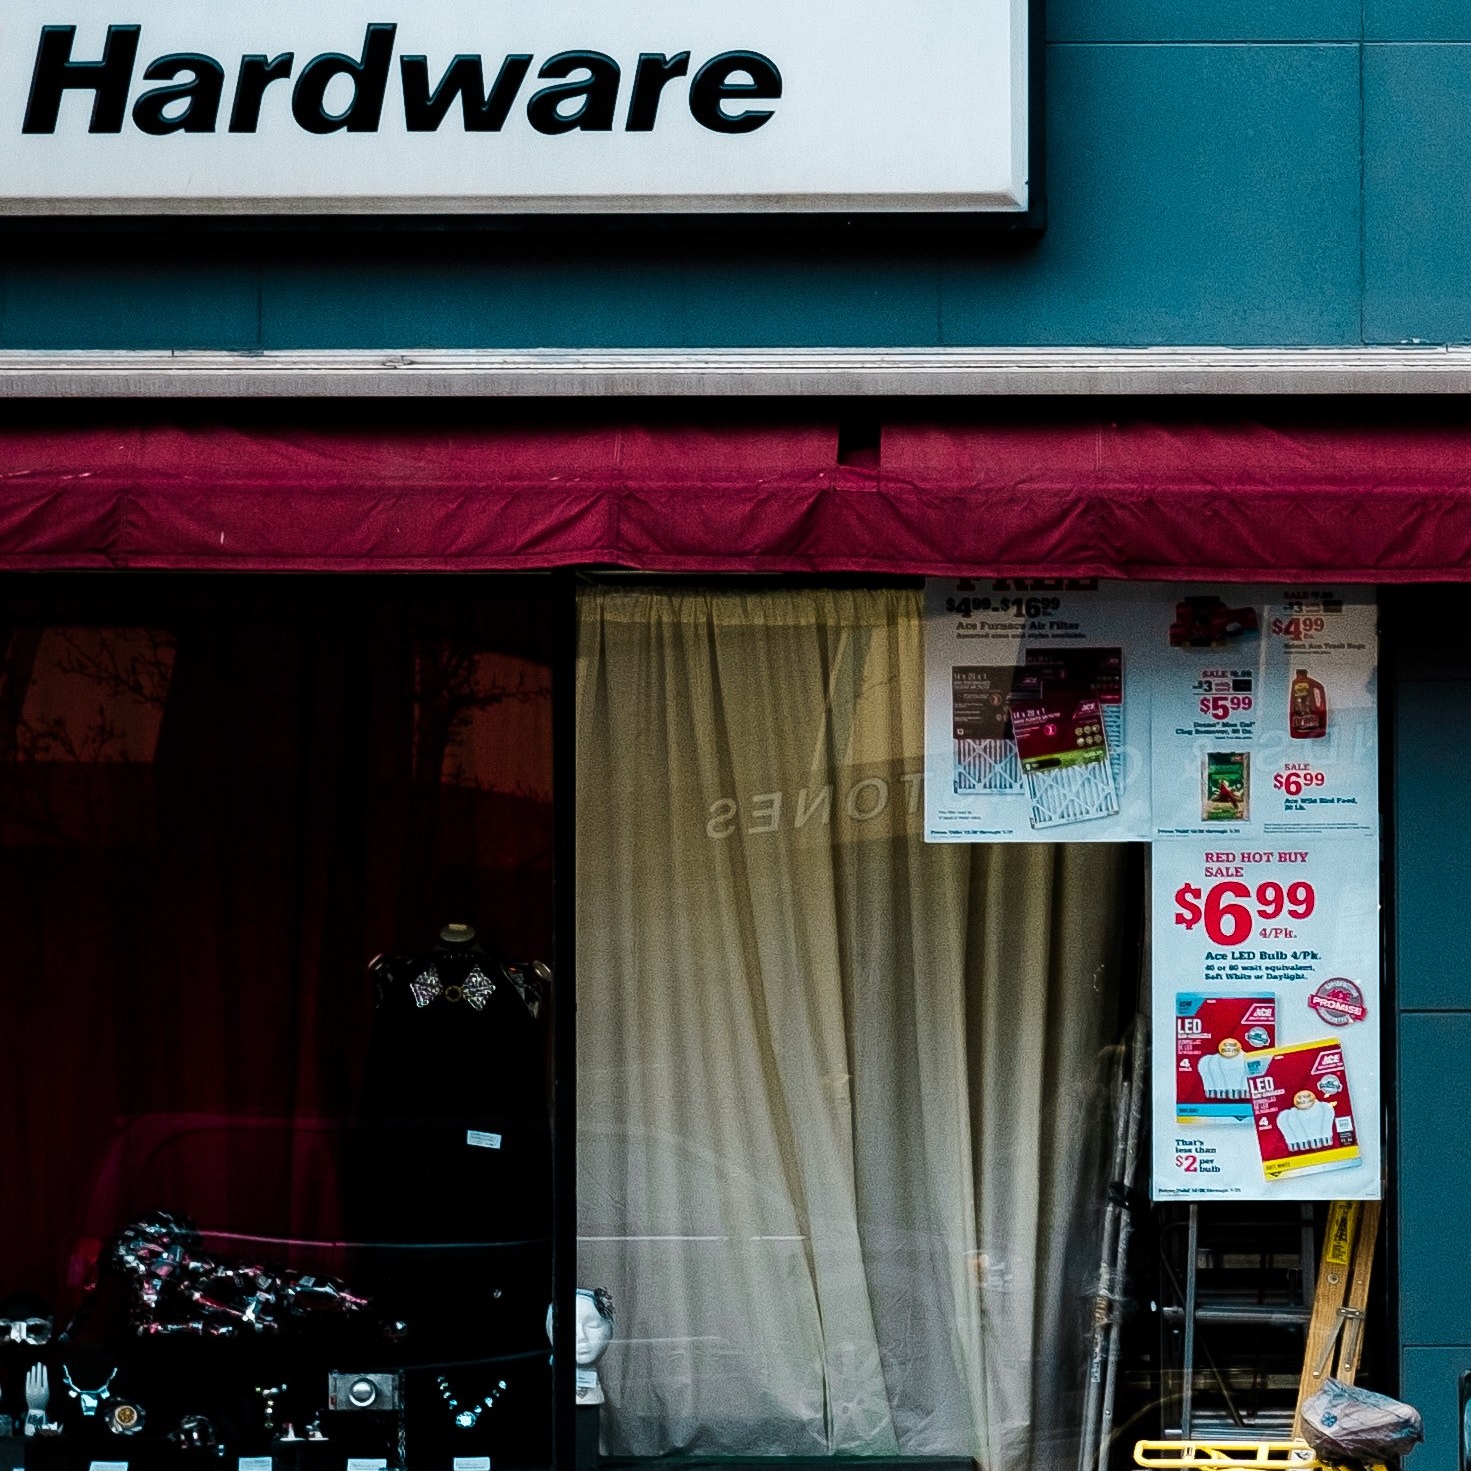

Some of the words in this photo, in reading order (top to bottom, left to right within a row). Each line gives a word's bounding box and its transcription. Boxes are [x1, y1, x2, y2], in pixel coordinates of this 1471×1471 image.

[21, 22, 783, 136] Hardware
[956, 621, 978, 630] Ace
[980, 621, 1026, 630] Furnace
[1029, 621, 1046, 630] Air
[1049, 621, 1080, 630] Filter
[1284, 763, 1310, 771] SALE
[1204, 852, 1236, 863] RED
[1240, 852, 1274, 863] HOT
[1277, 851, 1309, 863] BUY
[1204, 866, 1244, 878] SALE
[1259, 927, 1298, 939] 4/Pk.
[1204, 951, 1228, 961] Ace
[1231, 951, 1256, 961] LED
[1259, 950, 1288, 961] Bulb
[1290, 950, 1322, 961] 4/Pk.
[1204, 973, 1223, 981] Soft
[1225, 972, 1252, 981] White
[1311, 996, 1363, 1016] PROMISE
[1253, 1007, 1273, 1017] ACE
[1177, 1018, 1202, 1034] LED
[1322, 1054, 1341, 1065] ACE
[1248, 1076, 1275, 1093] LED
[1175, 1138, 1205, 1147] That's
[1175, 1154, 1198, 1173] $2
[1199, 1158, 1215, 1166] per
[1199, 1165, 1221, 1173] bulb
